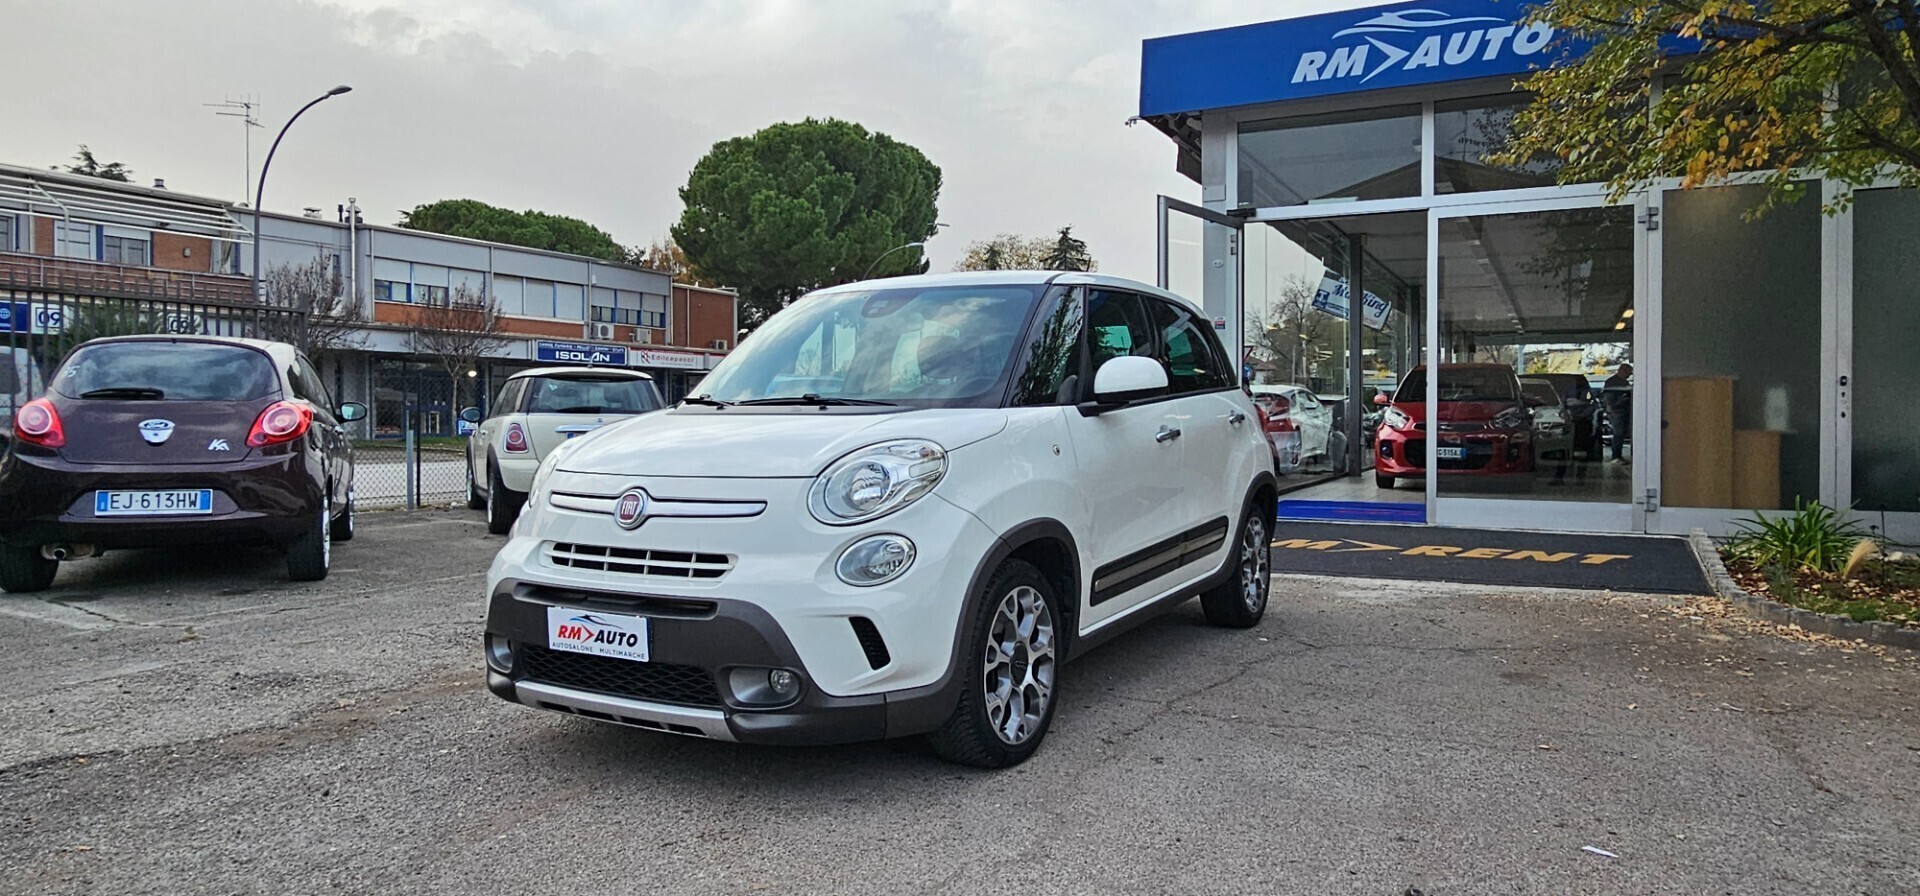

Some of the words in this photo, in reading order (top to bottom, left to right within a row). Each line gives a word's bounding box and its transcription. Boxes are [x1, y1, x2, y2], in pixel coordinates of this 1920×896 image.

[1290, 44, 1370, 84] RM
[1402, 20, 1554, 71] AUTO
[555, 350, 610, 362] ISOLAN
[620, 500, 638, 515] FIAT
[1399, 544, 1633, 564] RENT
[557, 624, 583, 641] RM
[593, 629, 639, 648] AUTO
[551, 641, 594, 653] AUTOSALONE
[599, 647, 646, 660] MULTIMARCHE
